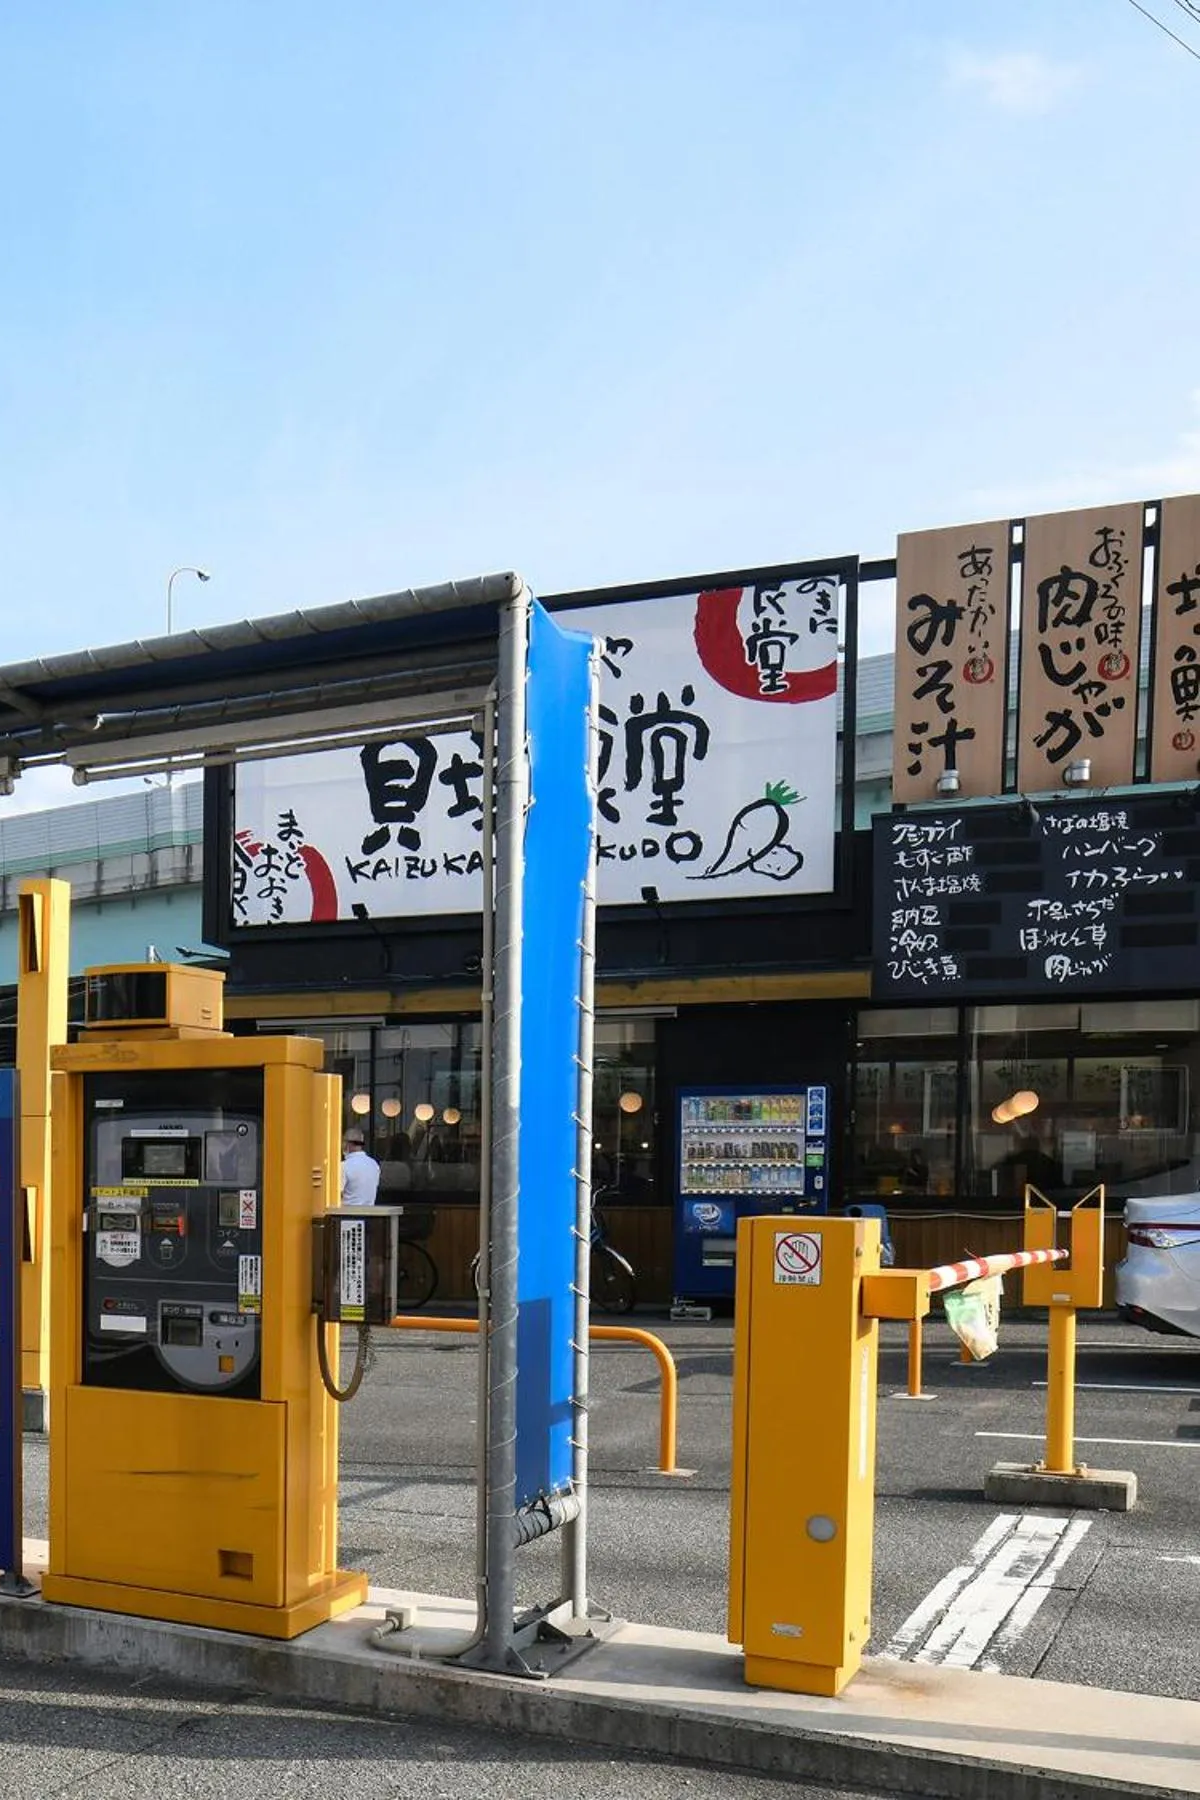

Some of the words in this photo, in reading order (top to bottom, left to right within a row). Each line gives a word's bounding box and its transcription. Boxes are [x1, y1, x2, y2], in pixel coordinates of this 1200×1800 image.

[1033, 565, 1125, 764] 肉じゃが
[906, 594, 976, 776] みそ汁
[892, 819, 962, 847] アジフライ
[1062, 831, 1163, 859] ハンバーグ
[345, 850, 484, 883] KAIZUKA
[894, 845, 973, 876] もずく酢
[894, 873, 981, 902] さんま塩焼
[891, 905, 941, 932] 納豆
[890, 929, 938, 958] 冷奴
[1019, 922, 1107, 951] ほうれん草
